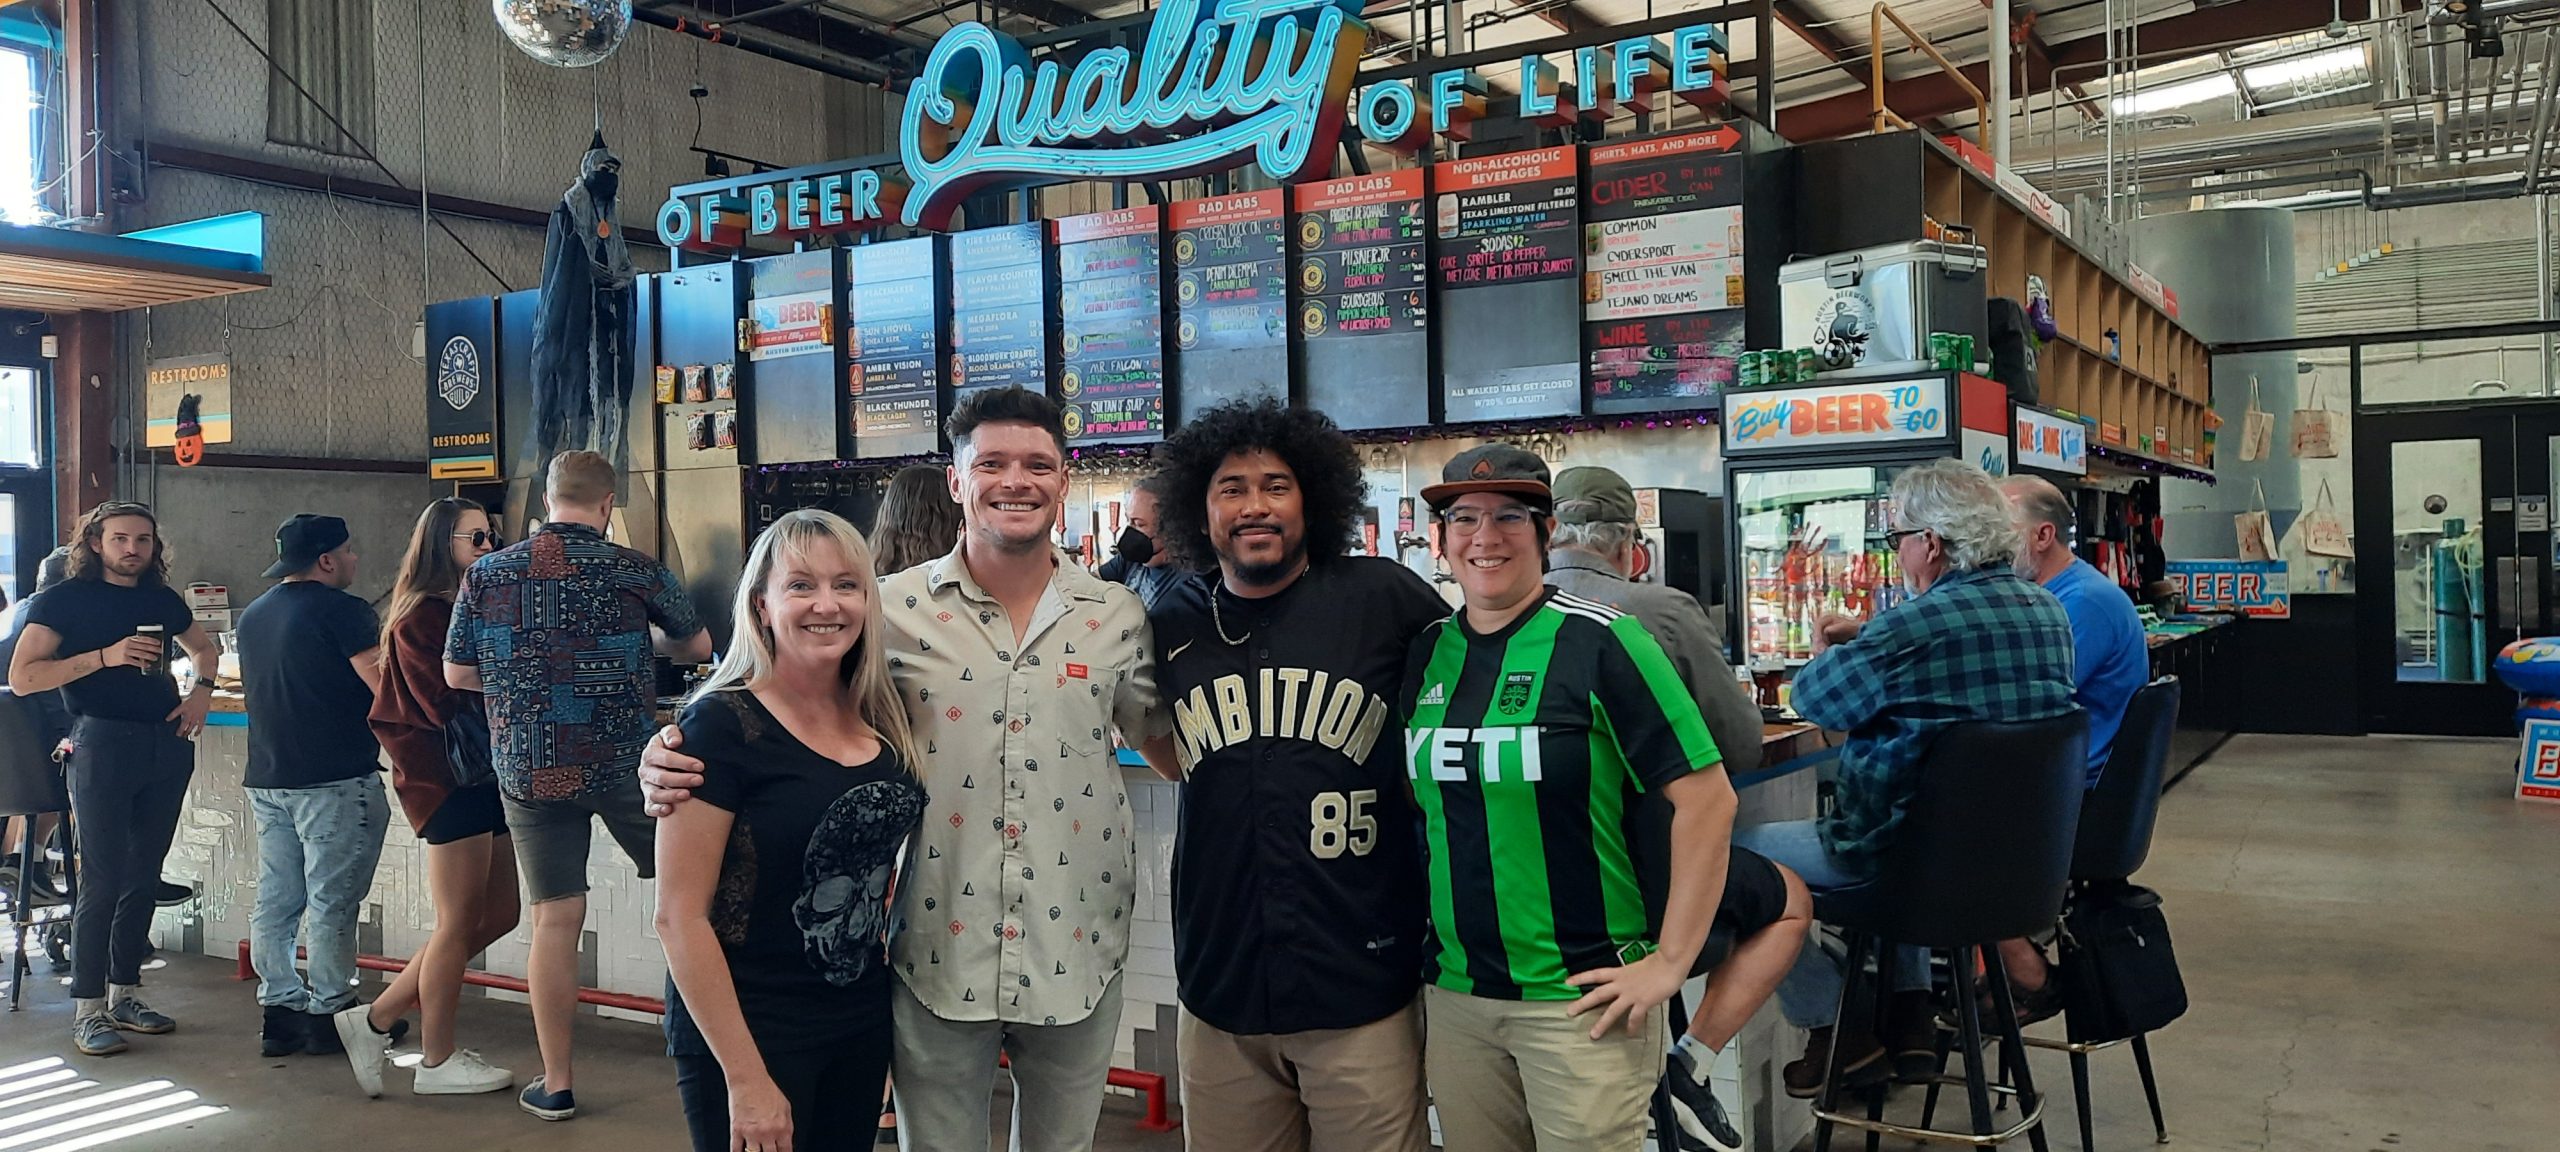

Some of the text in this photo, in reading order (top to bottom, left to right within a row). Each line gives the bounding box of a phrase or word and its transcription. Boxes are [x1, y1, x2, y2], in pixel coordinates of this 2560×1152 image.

[1358, 23, 1713, 143] OF LIFE
[901, 0, 1335, 225] Quality
[1594, 134, 1718, 161] SHIRTS, HATS, AND MORE
[1453, 150, 1561, 175] NON-ALCOHOLIC
[1471, 166, 1542, 185] BEVERAGES
[1327, 176, 1393, 196] RAD LABS
[1591, 171, 1668, 205] CIDER
[656, 169, 882, 247] OF BEER
[1198, 196, 1258, 215] RAD LABS
[1461, 193, 1511, 208] RAMBLER
[1462, 198, 1576, 219] TEXAS LIMESTONE FILTERED
[1079, 211, 1135, 228] RAD LABS
[1462, 212, 1547, 230] SPARKLING WATER
[1604, 217, 1657, 236] COMMON
[1341, 249, 1378, 267] PILSNER
[1467, 252, 1496, 267] SPRITE
[1514, 245, 1547, 261] PEPPER
[1607, 244, 1677, 263] CYDERSPORT
[1000, 268, 1040, 281] COUNTRY
[1604, 263, 1697, 284] SMELL THE VAN
[1608, 294, 1650, 309] TEJANO
[1653, 290, 1698, 305] DREAMS
[778, 301, 817, 325] BEER
[967, 311, 1018, 324] MEGAFLORA
[882, 323, 912, 334] SHOVEL
[1599, 323, 1648, 345] WINE
[442, 341, 476, 377] TEXAS CRAFT
[865, 360, 922, 373] AMBER VISION
[1111, 359, 1143, 371] FALCON
[151, 364, 228, 386] RESTROOMS
[866, 374, 885, 382] AMBER
[449, 388, 470, 405] GUILD
[1451, 379, 1574, 397] ALL WALKED TABS GET CLOSED
[866, 399, 930, 412] BLACK THUNDER
[1732, 385, 1920, 441] Buy BEER TO
[866, 412, 907, 421] BLACK LAGER
[1905, 407, 1938, 433] GO
[432, 433, 491, 448] RESTROOMS
[2168, 572, 2262, 603] BEER
[1172, 667, 1388, 783] AMBITION
[1404, 725, 1543, 783] YETI
[1310, 789, 1378, 859] 85
